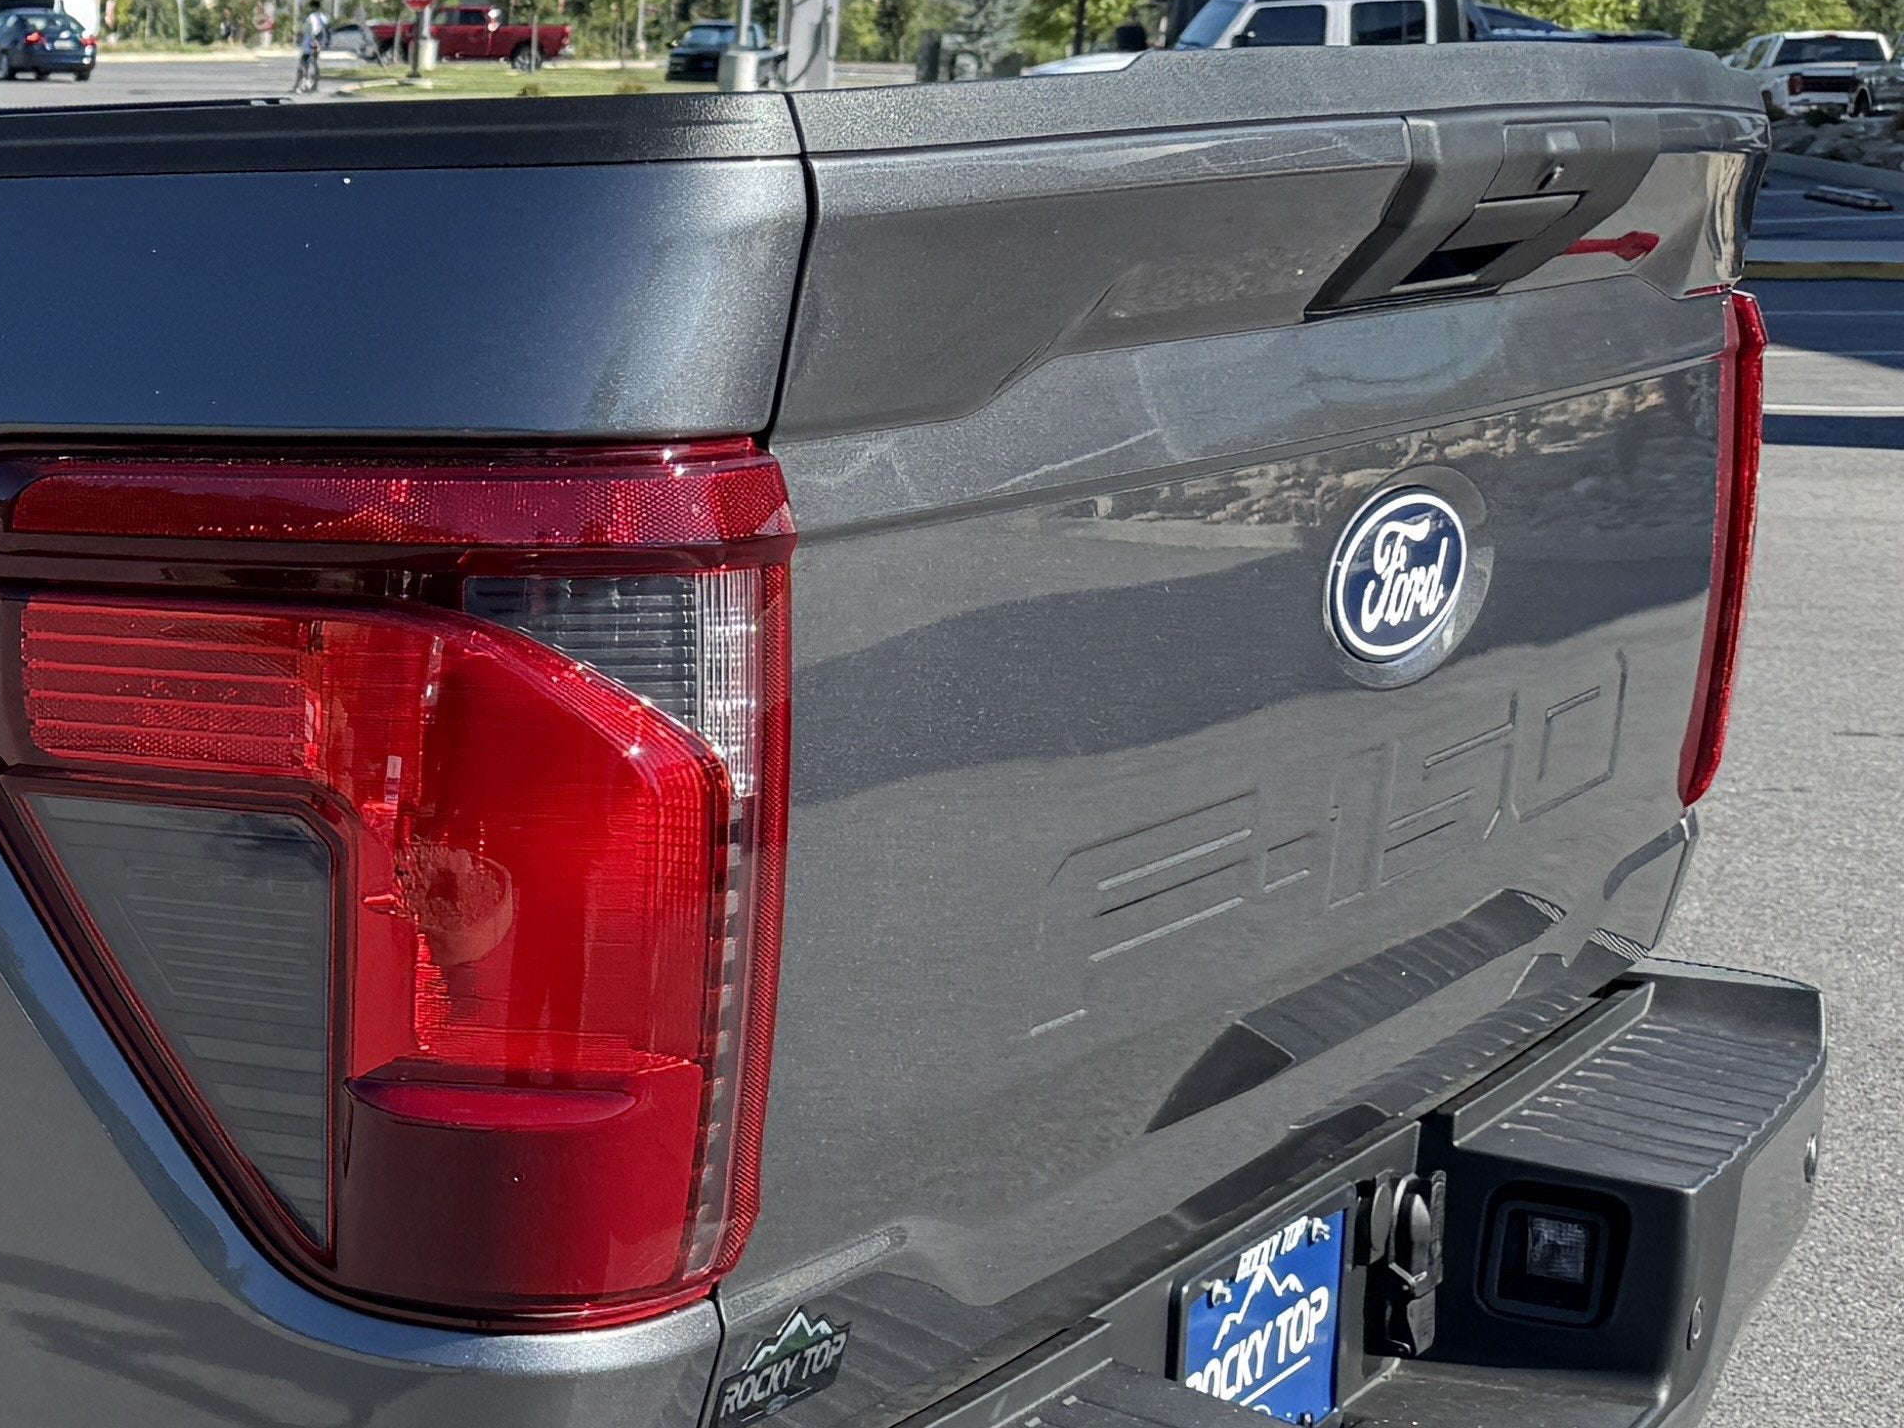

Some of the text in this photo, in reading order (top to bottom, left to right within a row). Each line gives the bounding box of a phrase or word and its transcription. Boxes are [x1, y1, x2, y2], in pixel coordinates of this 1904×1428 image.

[1361, 518, 1449, 634] Ford
[1275, 1286, 1329, 1364] TOP
[719, 1332, 847, 1418] ROCKY TOP
